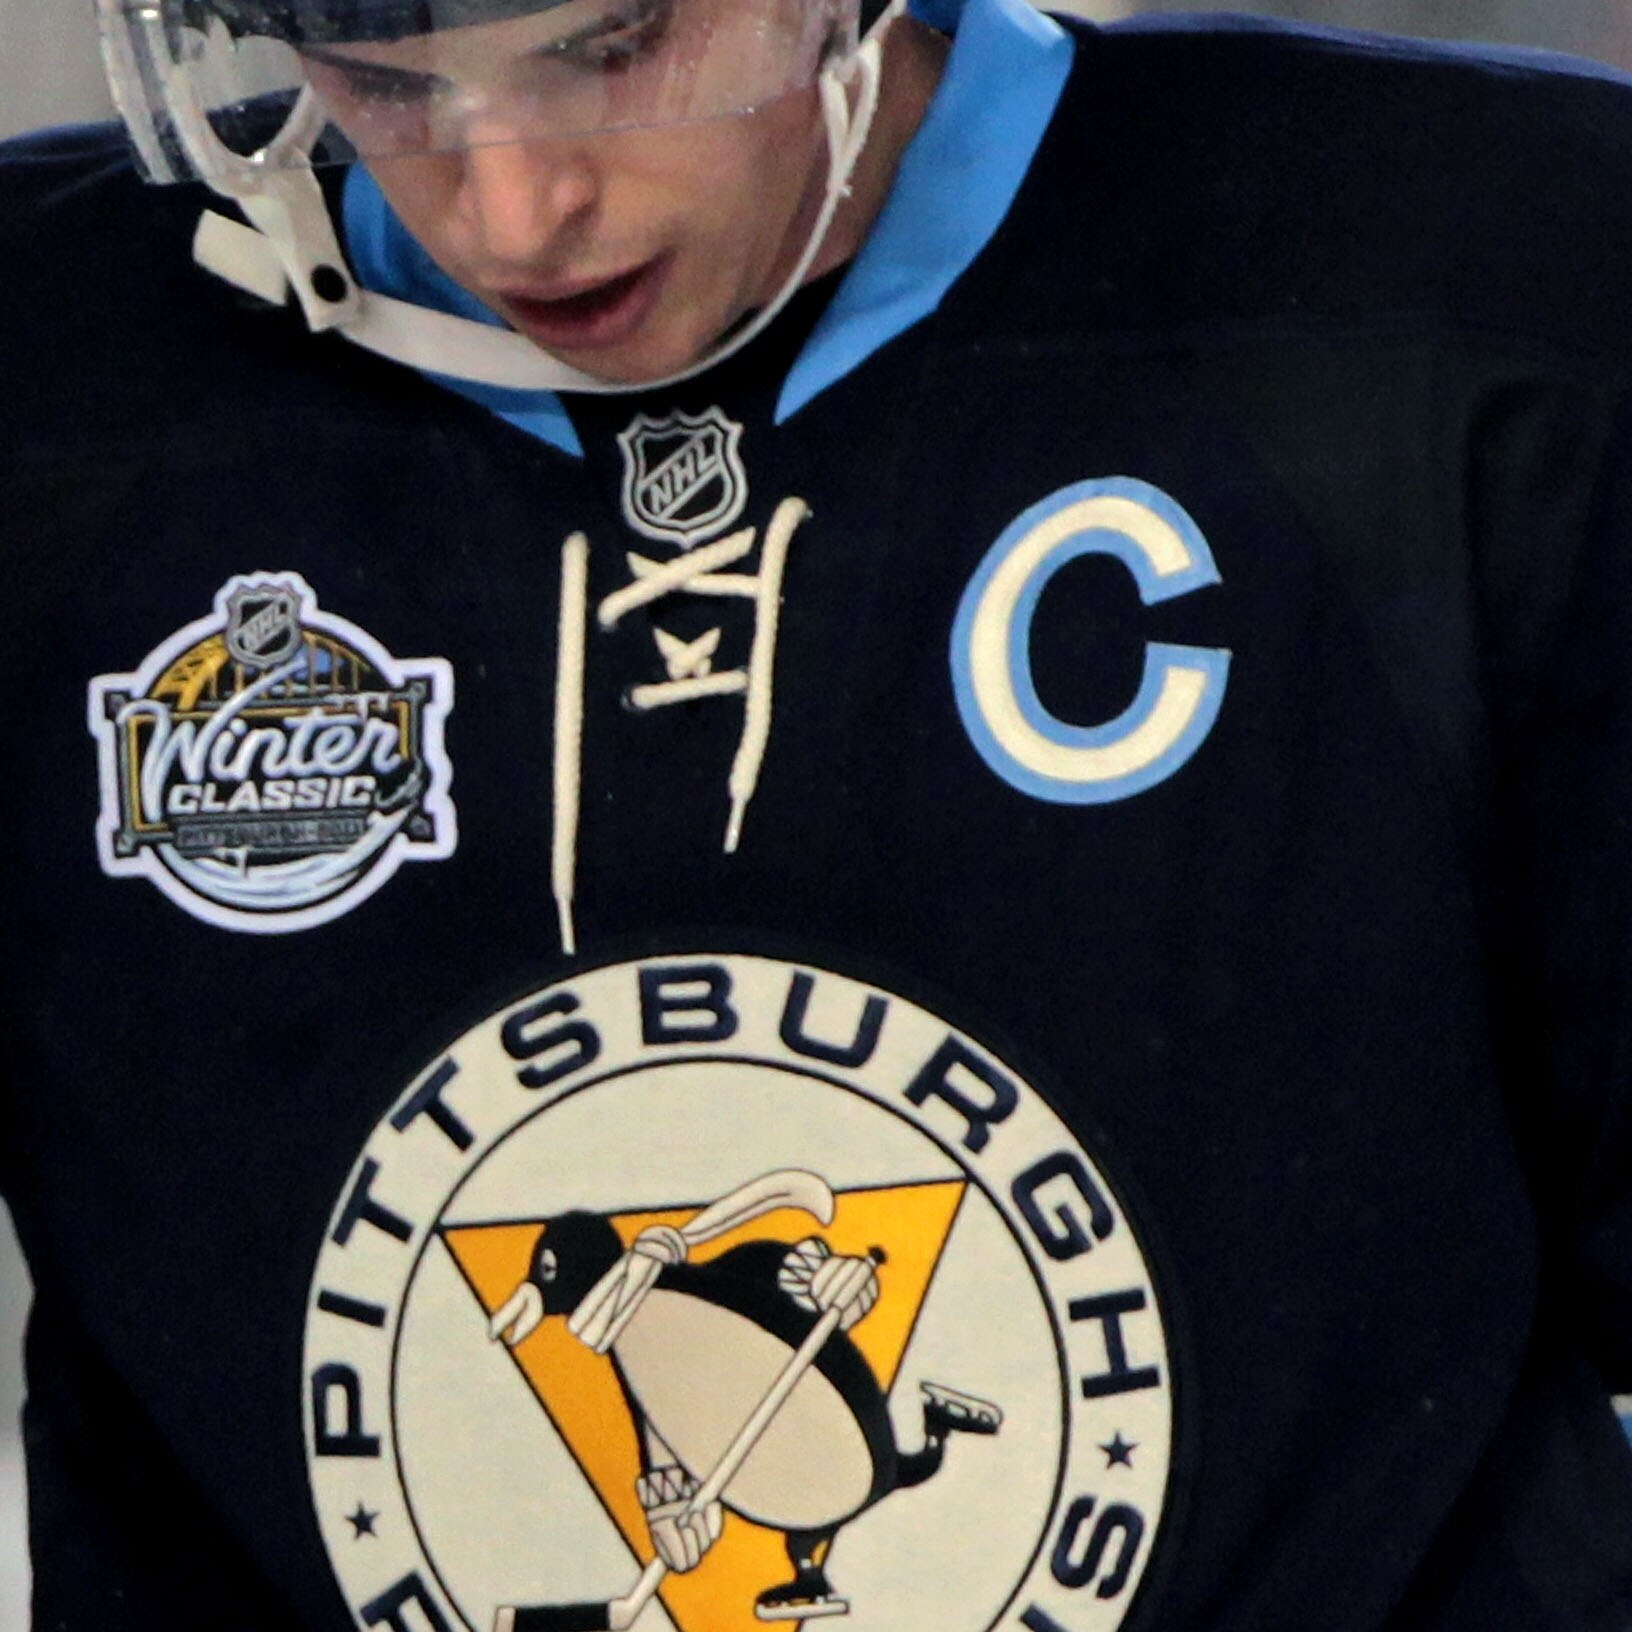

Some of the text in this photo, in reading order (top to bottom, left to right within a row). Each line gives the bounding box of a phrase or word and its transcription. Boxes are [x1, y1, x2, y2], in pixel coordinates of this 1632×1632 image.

[649, 436, 717, 516] NHL
[950, 475, 1232, 805] C
[115, 655, 404, 823] Winter
[168, 775, 377, 815] CLASSIC
[312, 963, 1161, 1458] PITTSBURGH
